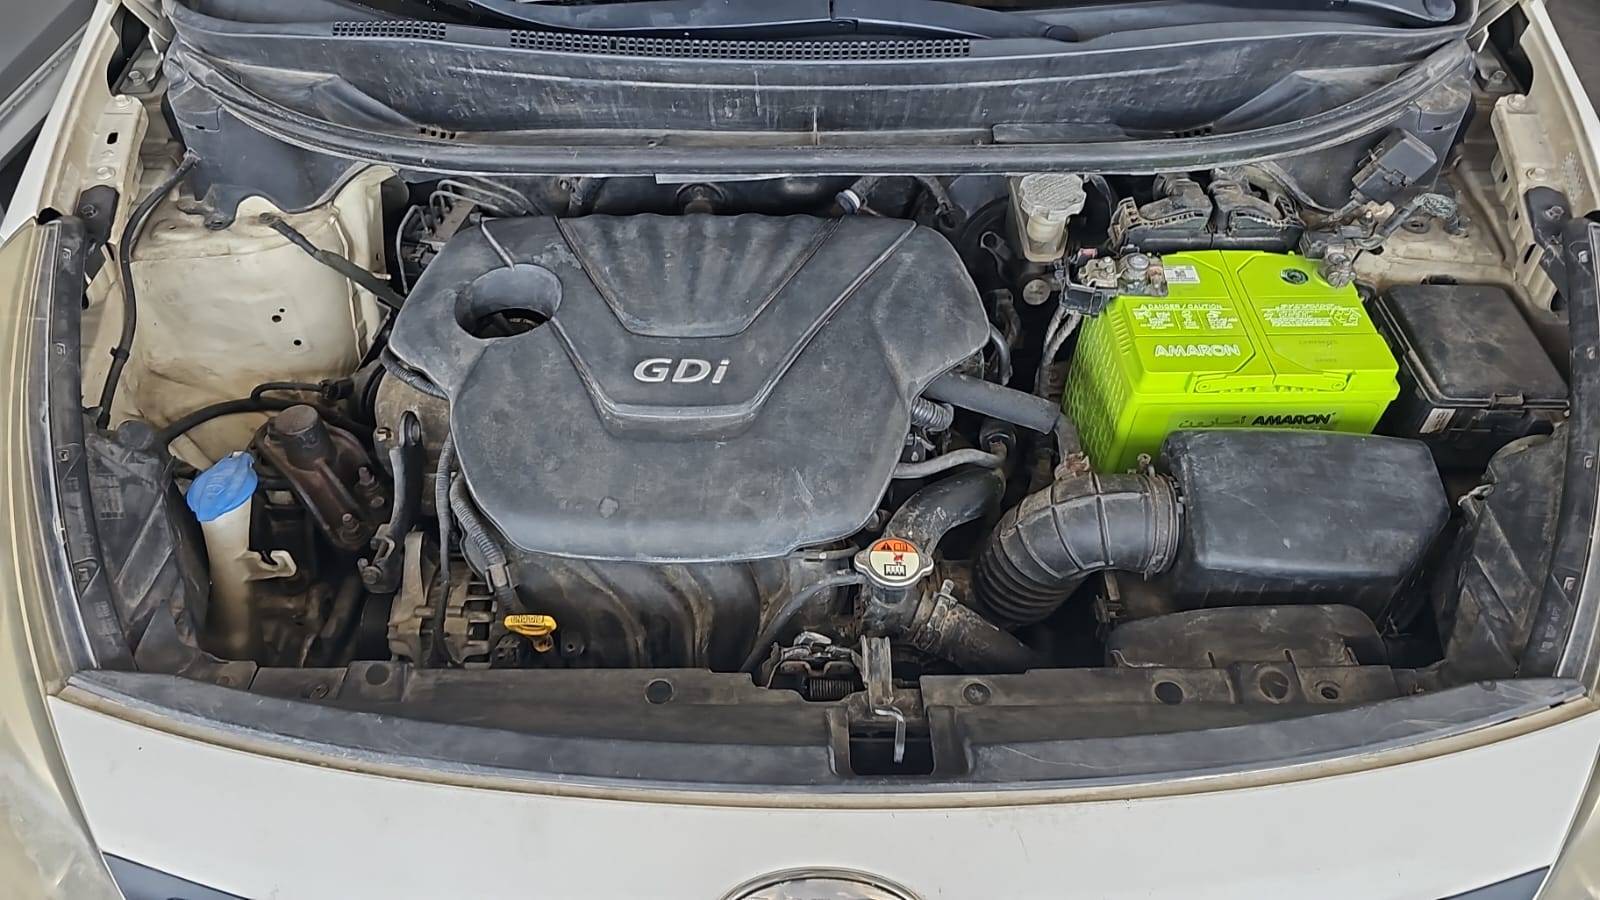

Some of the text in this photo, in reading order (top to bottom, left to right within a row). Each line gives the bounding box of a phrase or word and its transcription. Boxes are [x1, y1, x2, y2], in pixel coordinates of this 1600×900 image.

[1154, 343, 1241, 357] AMARON
[633, 358, 730, 384] GDi
[1251, 412, 1332, 426] AMARON
